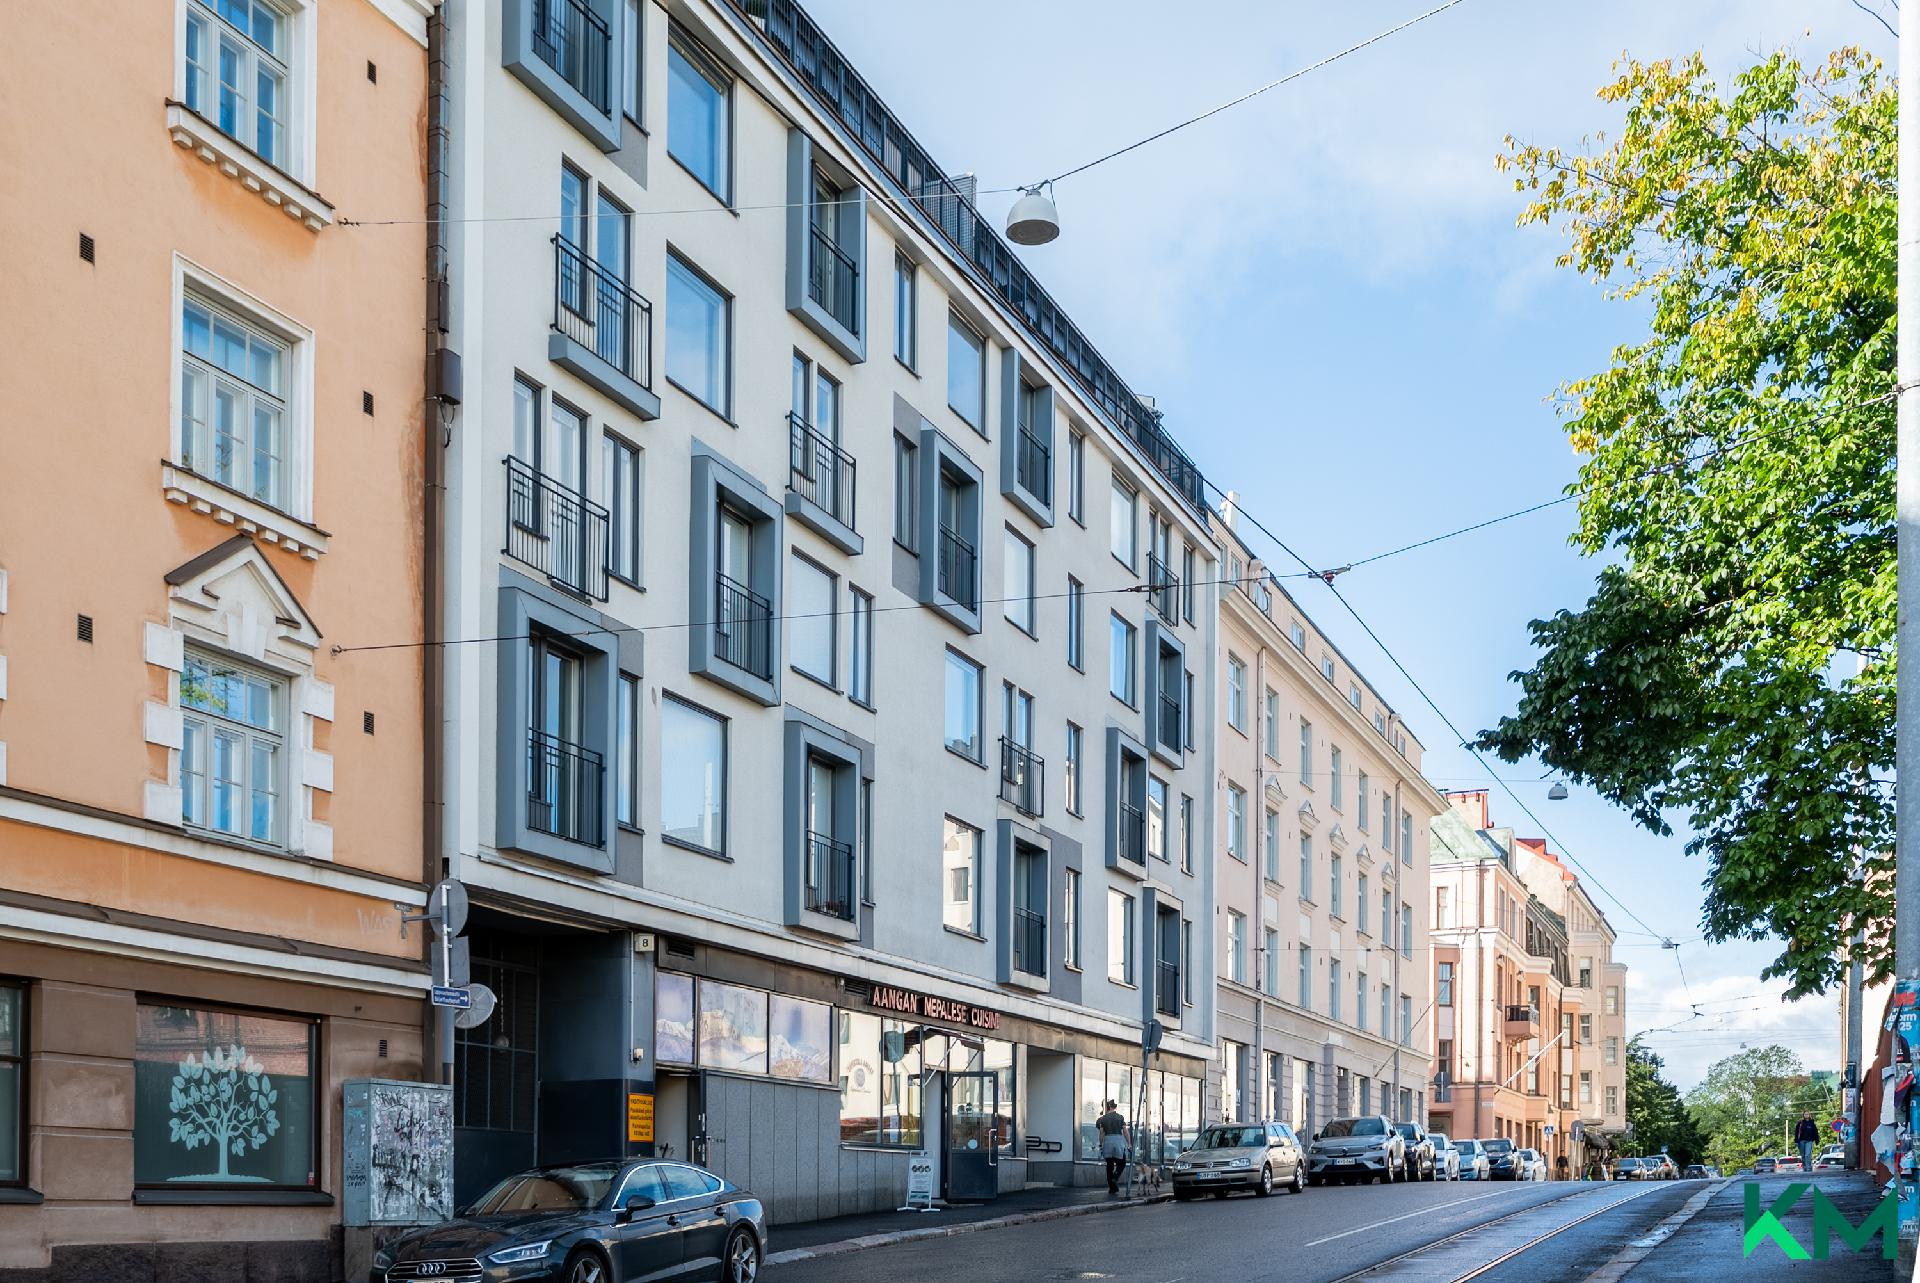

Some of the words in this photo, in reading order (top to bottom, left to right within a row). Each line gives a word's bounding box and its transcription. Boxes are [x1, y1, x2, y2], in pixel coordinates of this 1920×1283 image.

[642, 938, 649, 948] 8
[872, 986, 918, 1014] AANGAN
[924, 996, 967, 1023] NEPALESE
